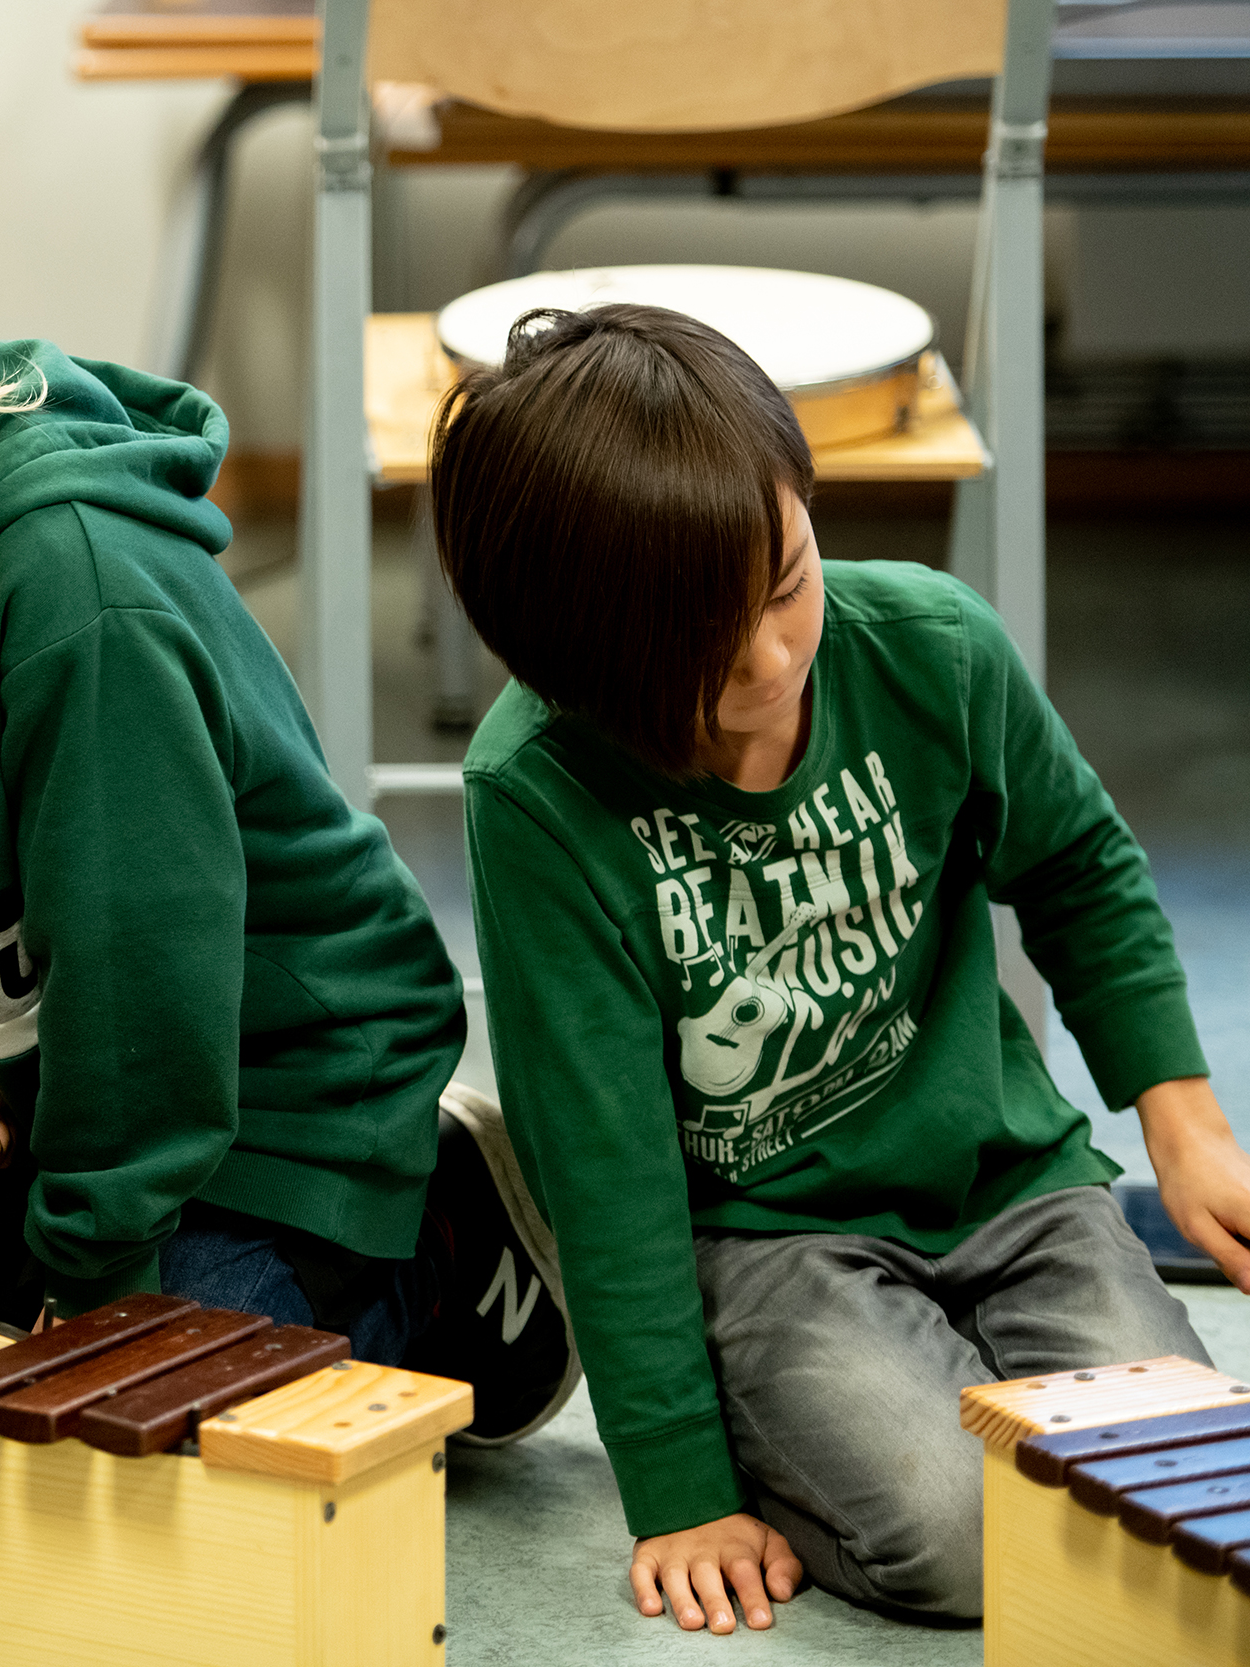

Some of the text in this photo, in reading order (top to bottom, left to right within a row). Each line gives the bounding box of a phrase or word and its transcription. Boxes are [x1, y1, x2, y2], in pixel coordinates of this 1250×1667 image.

[631, 808, 717, 875] SEE
[787, 751, 897, 849] HEAR
[655, 811, 920, 965] BEATNIK
[746, 887, 923, 1011] MUSIC
[678, 1126, 740, 1164] HUR.
[741, 1123, 795, 1172] STREET
[475, 1245, 542, 1345] N
